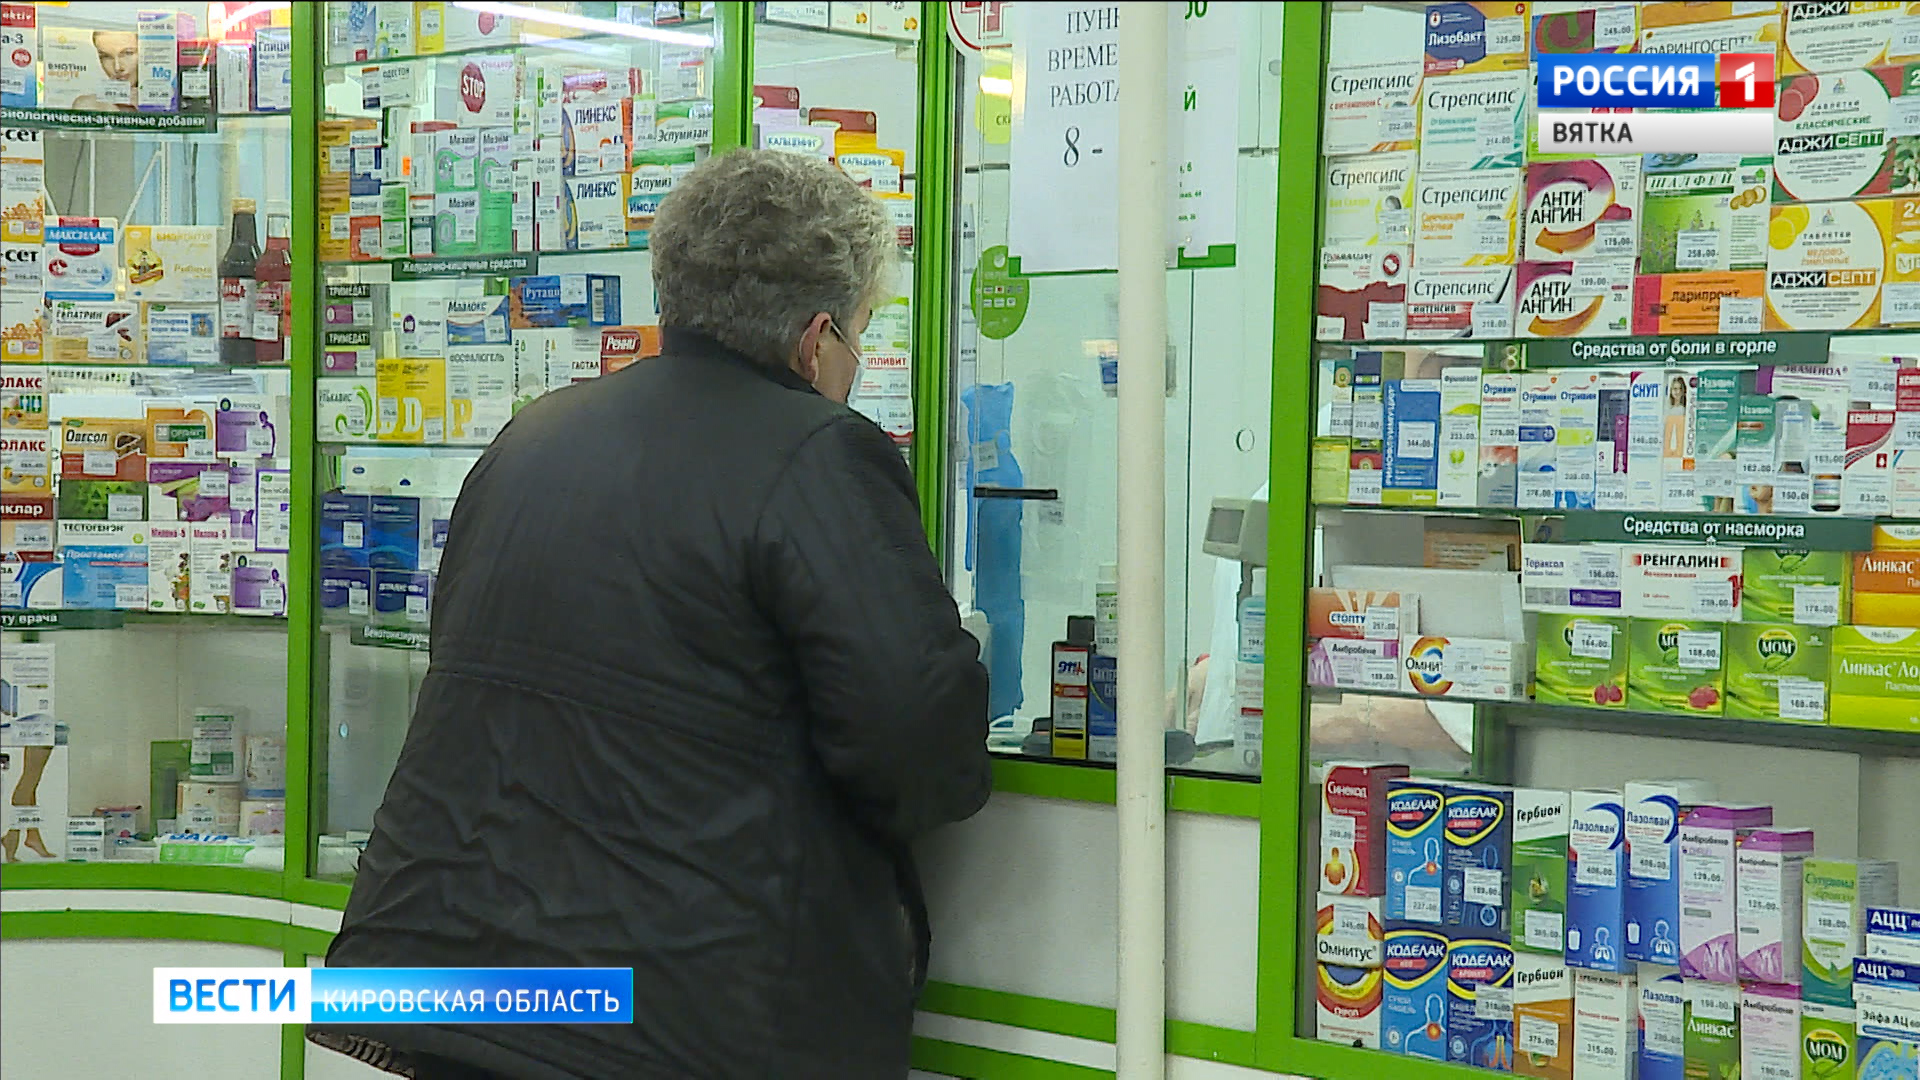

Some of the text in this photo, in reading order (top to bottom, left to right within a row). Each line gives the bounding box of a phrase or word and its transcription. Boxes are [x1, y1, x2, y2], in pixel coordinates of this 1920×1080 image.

[1429, 32, 1482, 46] Лизобакт
[463, 76, 484, 98] STOP
[1331, 74, 1414, 95] Стрепсилс
[1429, 91, 1514, 111] Стрепсилс
[158, 116, 205, 127] добавки
[575, 105, 616, 124] ЛИНЕКС
[658, 130, 709, 142] Эспумизан
[1779, 130, 1884, 153] АДЖИСЕПТ
[1064, 126, 1080, 167] 8
[1331, 169, 1405, 188] Стрепсилс
[577, 181, 616, 199] ЛИНЕКС
[1422, 188, 1508, 207] Стрепсилс
[1541, 192, 1582, 207] АНТИ
[1531, 207, 1581, 224] АНГИН
[1772, 271, 1874, 287] АДЖИСЕПТ
[1414, 279, 1494, 299] Стрепсилс
[1521, 298, 1572, 314] АНГИН
[606, 337, 636, 350] Ренни
[1572, 340, 1776, 359] Средства от боли в горле
[1484, 384, 1516, 394] Отривин
[1633, 384, 1658, 398] СНУП
[1624, 517, 1804, 539] Средства от насморка
[1525, 557, 1564, 568] Тораксол
[1644, 554, 1718, 568] РЕНГАЛИН
[1862, 557, 1914, 573] Линкас
[19, 614, 57, 623] врача
[1762, 641, 1793, 653] МОМ
[1406, 658, 1442, 671] Омни
[1840, 658, 1892, 677] Линкас
[1328, 782, 1367, 798] Синекод
[1391, 800, 1438, 811] КОДЕЛАК
[1449, 807, 1497, 818] КОДЕЛАК
[1517, 806, 1561, 822] Гербион
[1627, 812, 1670, 826] Лазолван
[1573, 819, 1615, 833] Лазолван
[1871, 911, 1906, 931] АЦЦ
[1319, 942, 1372, 961] Омнитус
[1387, 945, 1444, 957] КОДЕЛАК
[1452, 954, 1511, 966] КОДЕЛАК
[1517, 969, 1563, 985] Гербион
[1857, 962, 1888, 979] АЦЦ
[1687, 1018, 1734, 1038] Линкас
[1893, 1016, 1908, 1028] АЦ
[1809, 1041, 1843, 1060] МОМ
